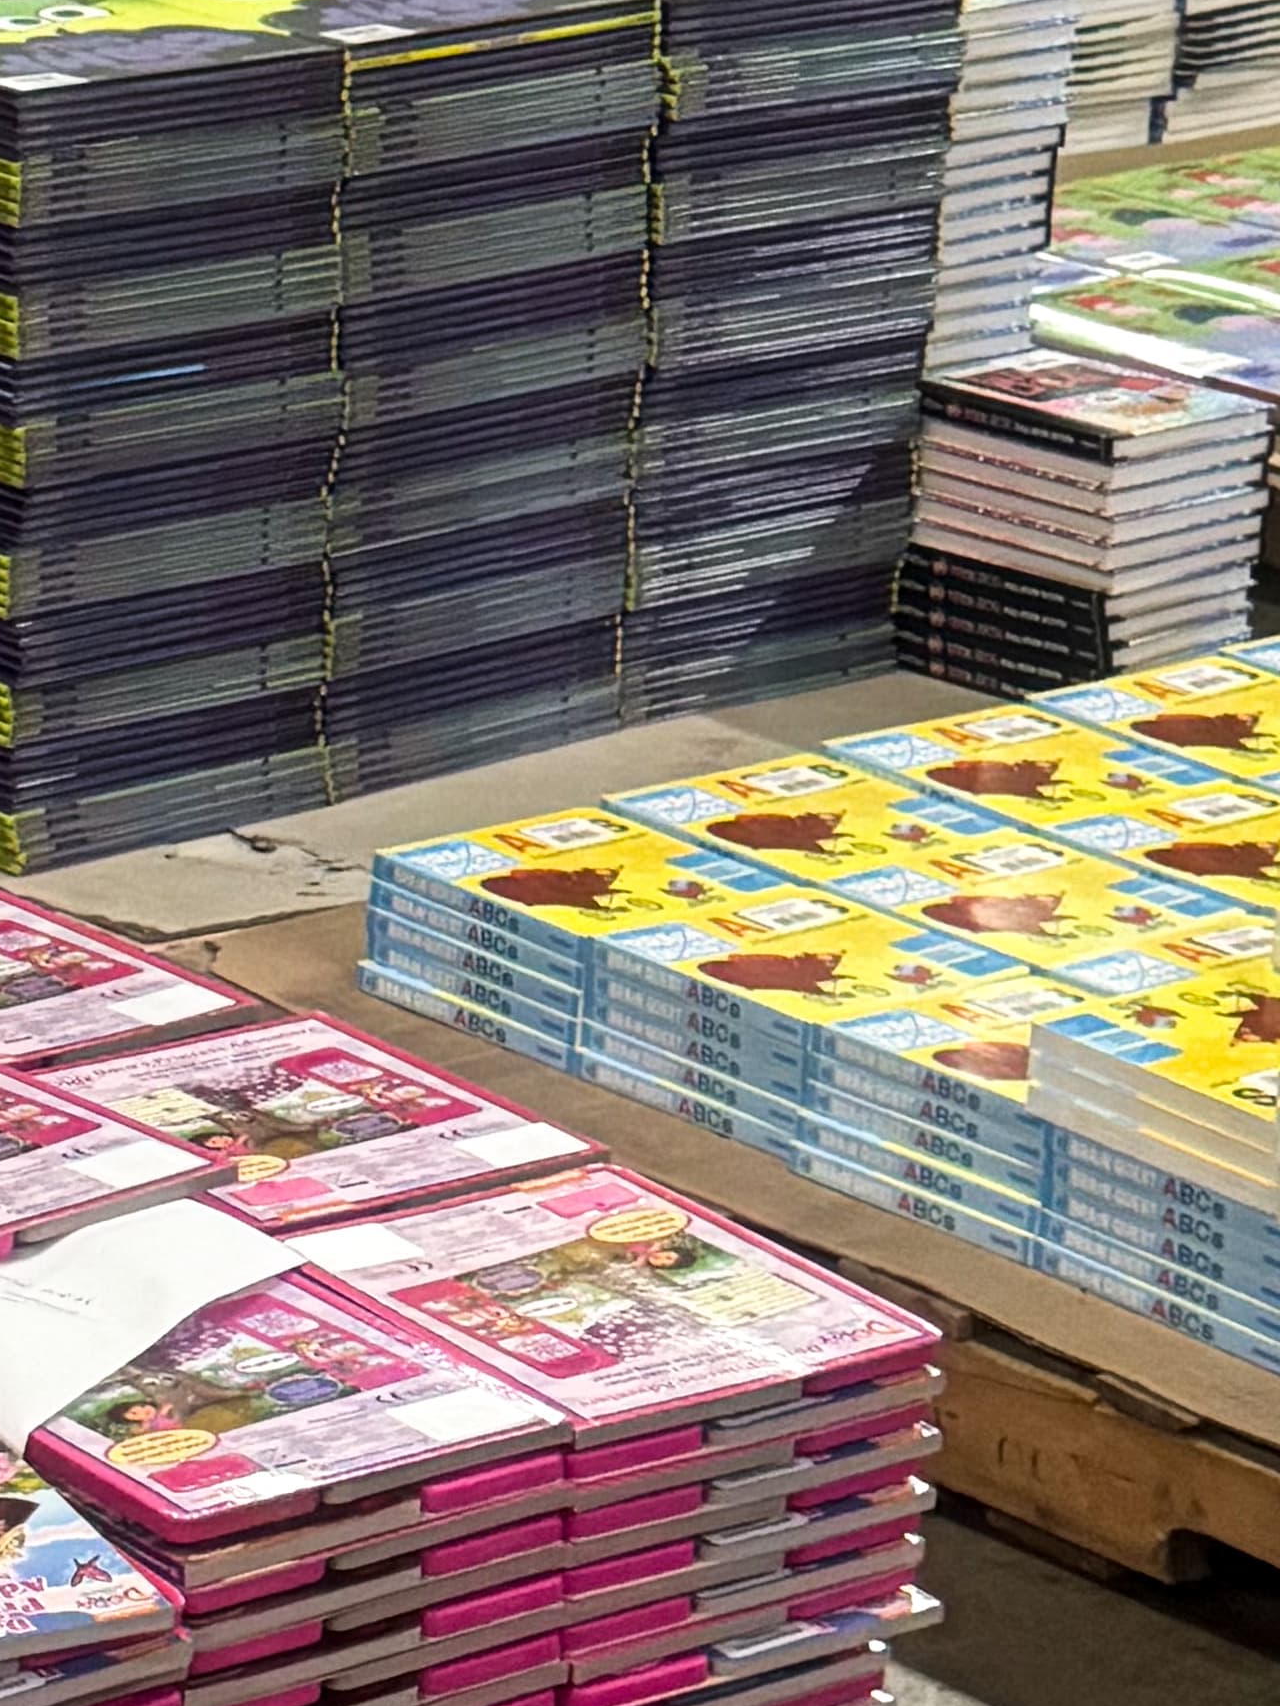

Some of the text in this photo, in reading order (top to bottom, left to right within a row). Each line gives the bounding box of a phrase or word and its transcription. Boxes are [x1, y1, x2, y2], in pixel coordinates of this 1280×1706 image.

[469, 900, 520, 934] ABCs
[467, 924, 519, 960] ABCs
[463, 953, 514, 987] ABCs
[460, 979, 512, 1015] ABCs
[685, 983, 741, 1019] ABCs
[454, 1008, 506, 1045] ABCs
[687, 1012, 741, 1049] ABCs
[686, 1042, 741, 1076] ABCs
[683, 1069, 737, 1105] ABCs
[921, 1071, 981, 1111] ABCs
[678, 1097, 734, 1135] ABCs
[919, 1101, 978, 1139] ABCs
[914, 1132, 973, 1168] ABCs
[903, 1162, 963, 1201] ABCs
[1163, 1177, 1226, 1220] ABCs
[897, 1193, 955, 1231] ABCs
[1161, 1207, 1224, 1250] ABCs
[1161, 1238, 1224, 1281] ABCs
[1157, 1268, 1219, 1311] ABCs
[1151, 1299, 1215, 1341] ABCs
